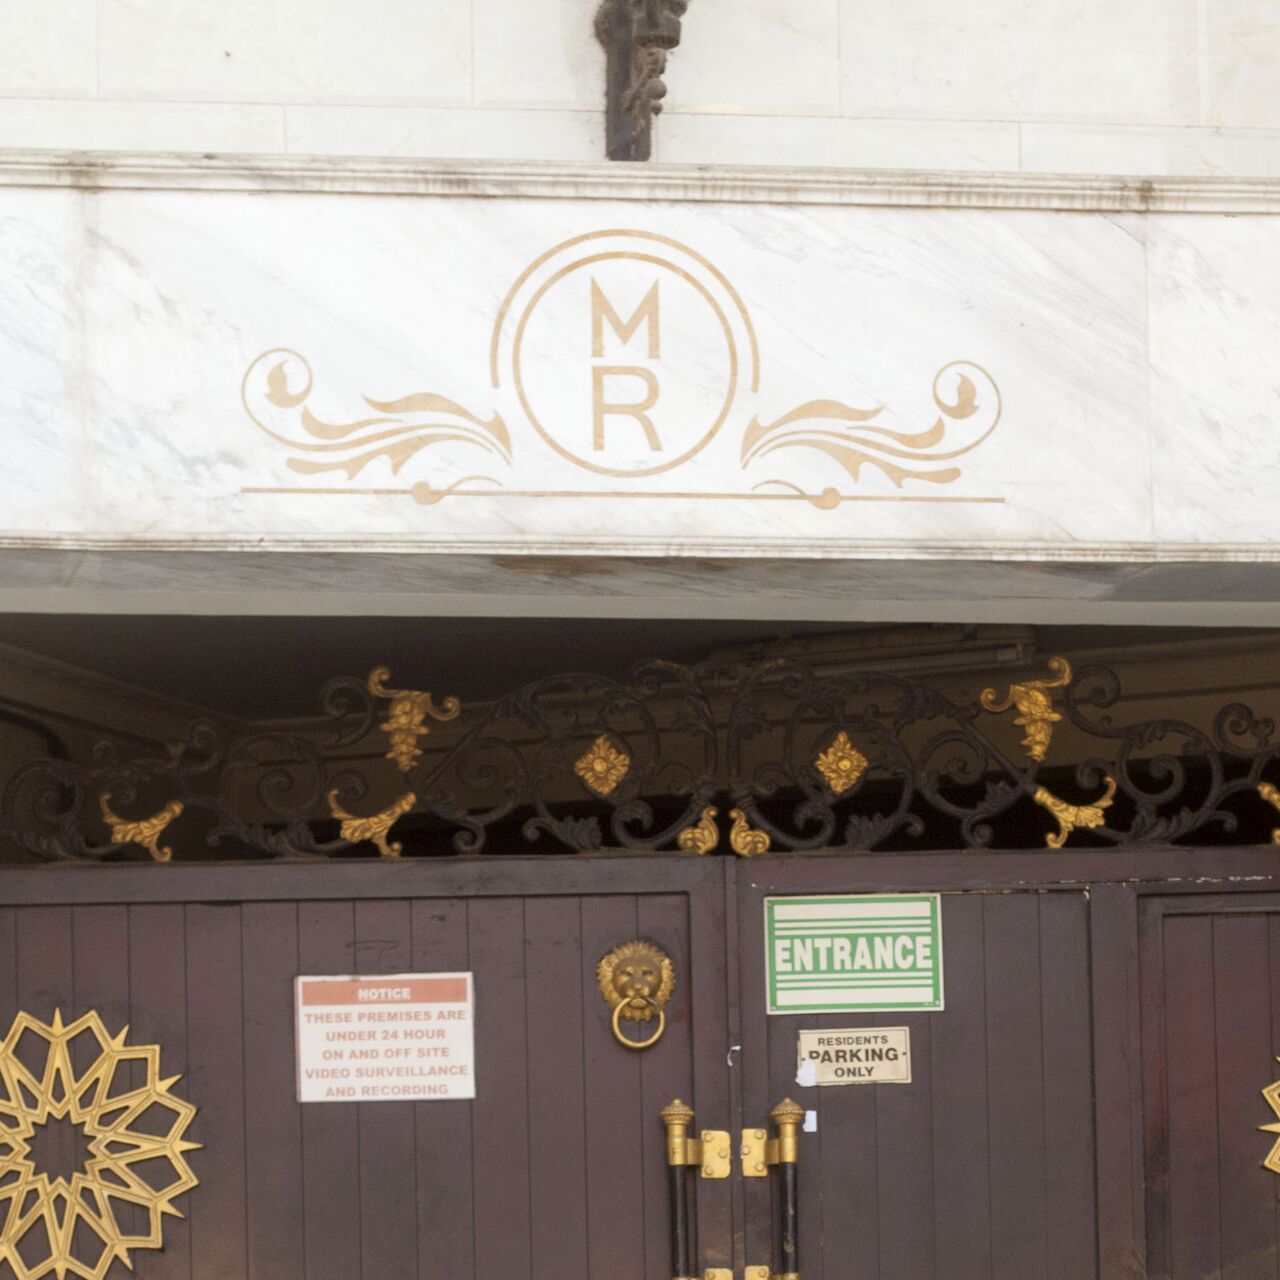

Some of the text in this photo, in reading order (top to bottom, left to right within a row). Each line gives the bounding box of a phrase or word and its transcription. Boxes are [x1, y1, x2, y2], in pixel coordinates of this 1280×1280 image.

[774, 935, 933, 972] ENTRANCE
[357, 987, 412, 1000] NOTICE
[304, 1009, 466, 1024] THESE PREMISES ARE
[326, 1028, 446, 1042] UNDER 24 HOUR
[817, 1035, 889, 1047] RESIDENTS
[322, 1046, 450, 1061] ON AND OFF SITE
[808, 1047, 899, 1064] PARKING
[305, 1064, 469, 1079] VIDEO SURVEILLANCE
[834, 1066, 875, 1079] ONLY
[325, 1083, 449, 1097] AND RECORDING
